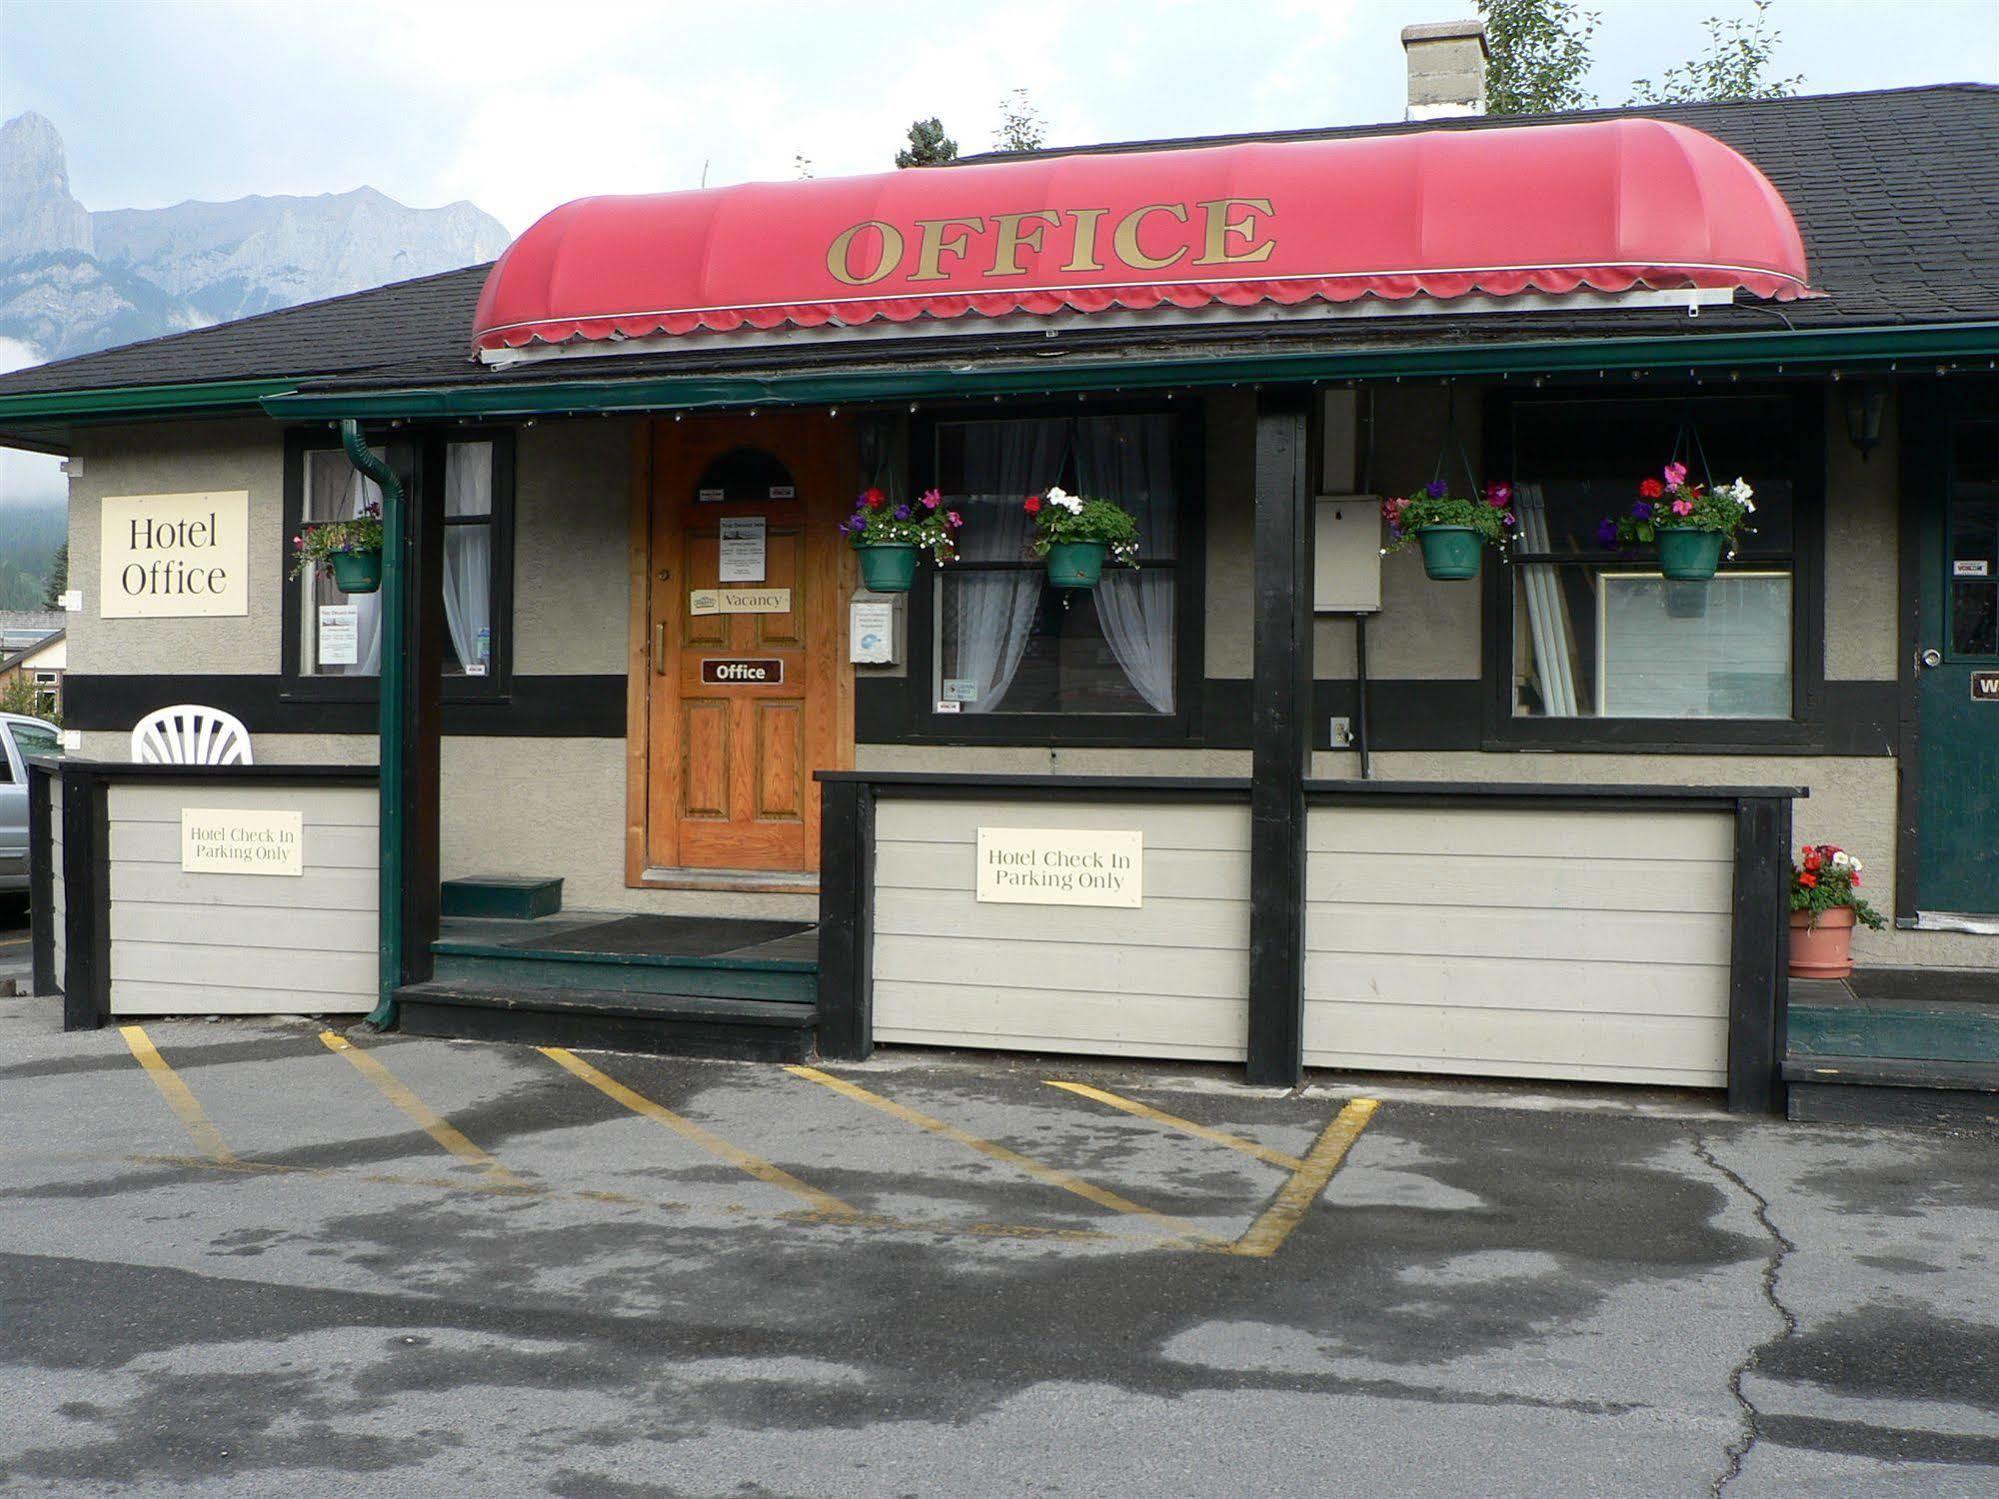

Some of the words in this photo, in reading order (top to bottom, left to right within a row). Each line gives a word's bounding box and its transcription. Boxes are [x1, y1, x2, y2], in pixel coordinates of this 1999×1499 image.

[826, 198, 1277, 285] OFFICE
[130, 512, 217, 550] Hotel
[122, 560, 227, 595] Office
[726, 594, 782, 608] Vacancy
[716, 664, 766, 679] Office
[191, 827, 225, 841] Hotel
[230, 828, 274, 842] Check
[280, 829, 294, 843] In
[196, 844, 252, 862] Parking
[256, 846, 289, 863] Only
[989, 849, 1036, 866] Hotel
[1043, 850, 1103, 868] Check
[1111, 853, 1131, 869] In
[996, 870, 1073, 891] Parking
[1078, 872, 1124, 893] Only
